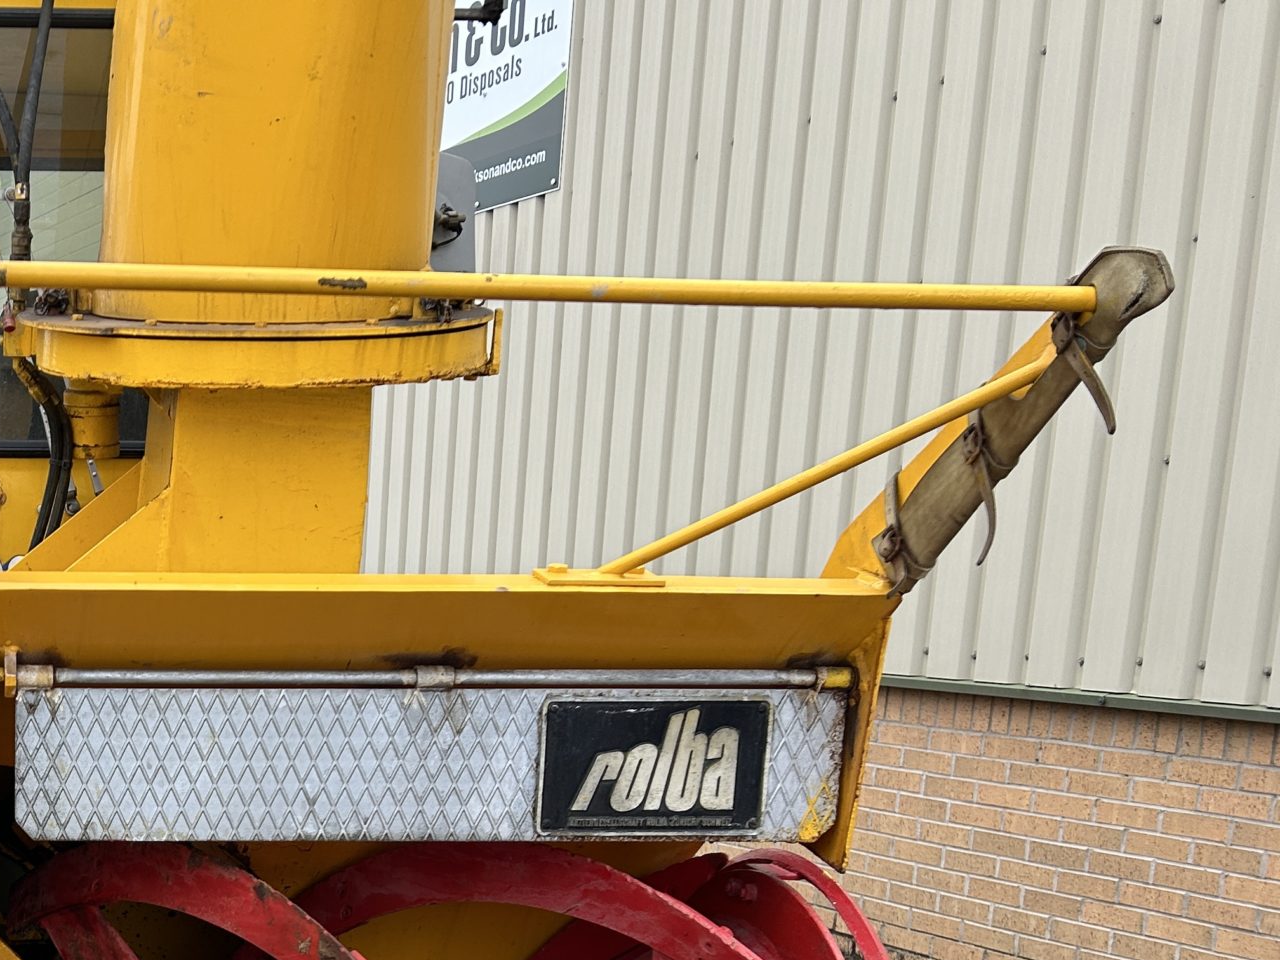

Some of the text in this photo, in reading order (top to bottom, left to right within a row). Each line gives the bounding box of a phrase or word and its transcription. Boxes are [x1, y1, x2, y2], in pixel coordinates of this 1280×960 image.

[534, 9, 558, 38] Ltd.
[459, 54, 522, 99] Disposals
[570, 708, 740, 812] rolba
